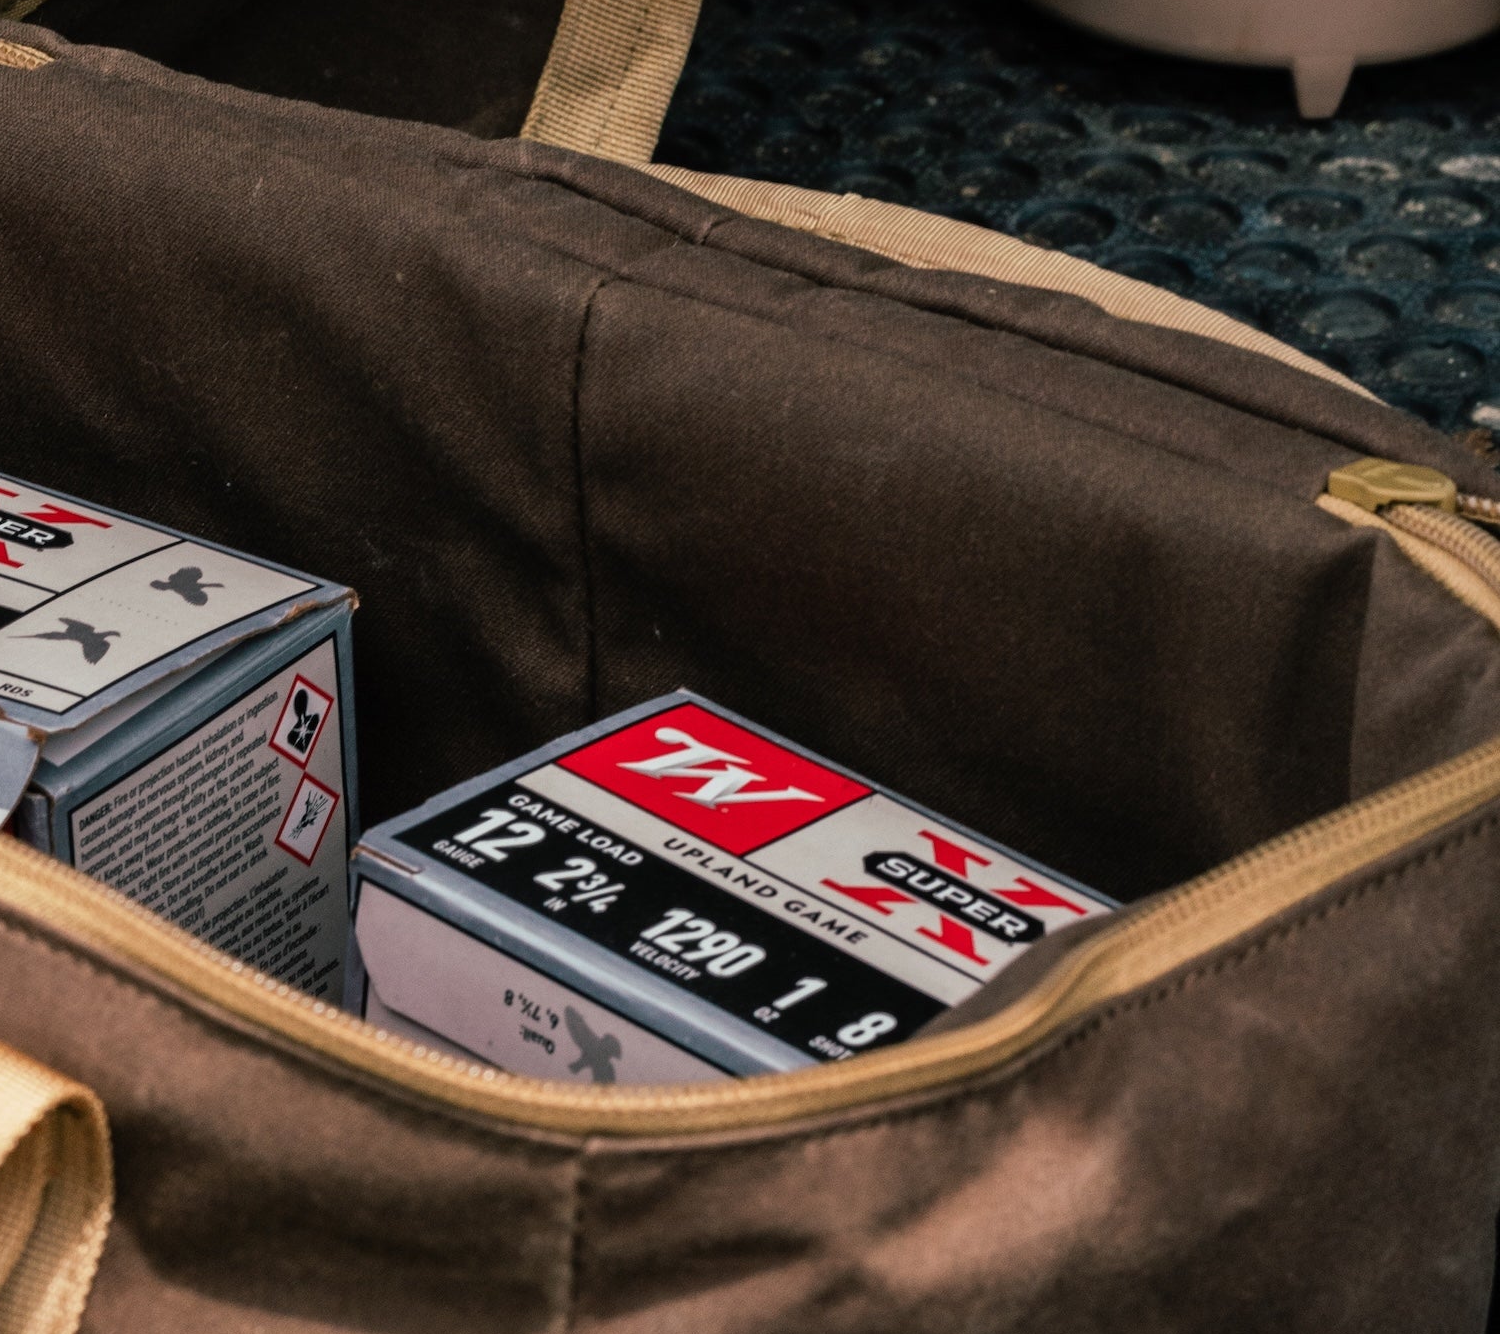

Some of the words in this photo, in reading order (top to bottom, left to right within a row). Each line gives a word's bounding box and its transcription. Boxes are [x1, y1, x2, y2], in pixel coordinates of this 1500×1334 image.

[80, 803, 111, 830] DANGER:
[114, 794, 128, 808] Fire
[139, 763, 174, 795] projection
[247, 692, 278, 719] ingestion
[81, 826, 106, 847] causes
[108, 805, 136, 829] damage
[148, 779, 176, 803] nervous
[205, 744, 229, 764] kidney,
[135, 806, 160, 828] system
[162, 785, 189, 811] through
[191, 759, 226, 793] prolonged
[237, 731, 266, 760] repeated
[151, 810, 179, 834] damage
[181, 792, 206, 814] fertility
[230, 759, 253, 782] unborn
[105, 864, 122, 881] Keep
[125, 851, 143, 868] away
[145, 839, 161, 855] from
[163, 826, 179, 843] heat
[254, 757, 278, 782] subject
[139, 873, 157, 892] Fight
[159, 866, 171, 879] fire
[172, 854, 188, 870] with
[190, 834, 214, 858] normal
[215, 807, 256, 844] precautions
[257, 796, 273, 812] from
[146, 853, 164, 870] Wear
[167, 828, 202, 860] protective
[243, 790, 258, 806] case
[162, 876, 180, 894] Store
[197, 846, 224, 870] dispose
[242, 806, 281, 840] accordance
[192, 866, 219, 890] breathe
[244, 834, 263, 853] Wash
[250, 849, 267, 867] drink
[508, 794, 580, 833] GAME
[575, 828, 644, 865] LOAD
[453, 808, 546, 862] 12
[639, 908, 767, 978] 1290
[772, 976, 828, 1010] 1
[836, 1012, 897, 1046] 8
[663, 838, 778, 899] UPLAND
[784, 900, 868, 944] GAME
[876, 857, 1029, 938] SUPER
[432, 839, 486, 869] GAUGE
[543, 896, 568, 912] IN
[629, 940, 700, 981] VELOCITY
[753, 1006, 780, 1023] OZ
[808, 1035, 854, 1060] SHOT
[504, 989, 514, 1006] 8
